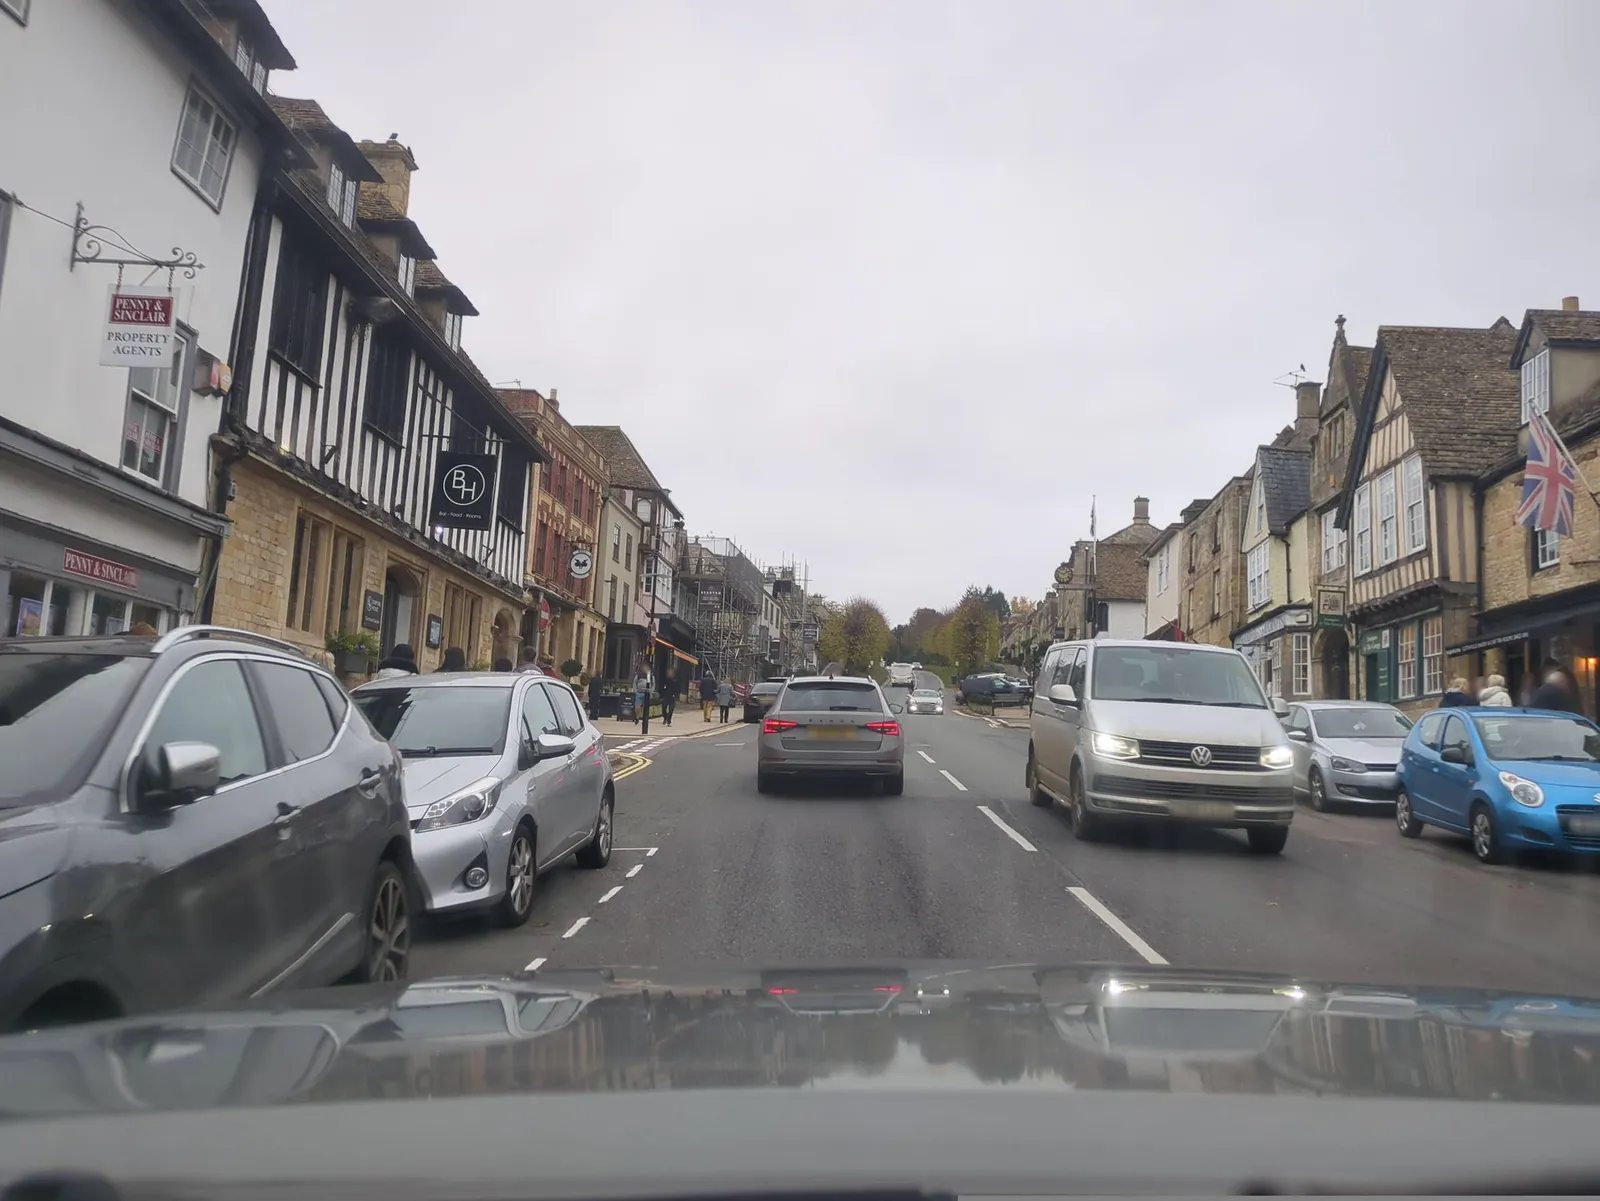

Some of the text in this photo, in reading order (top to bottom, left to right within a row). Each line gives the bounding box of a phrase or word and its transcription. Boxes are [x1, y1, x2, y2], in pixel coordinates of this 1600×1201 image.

[115, 298, 163, 311] PENNY &
[113, 309, 166, 322] SINCLAIR
[107, 332, 170, 343] PROPERTY
[113, 345, 162, 356] AGENTS
[65, 553, 136, 587] PENNY & SINCL
